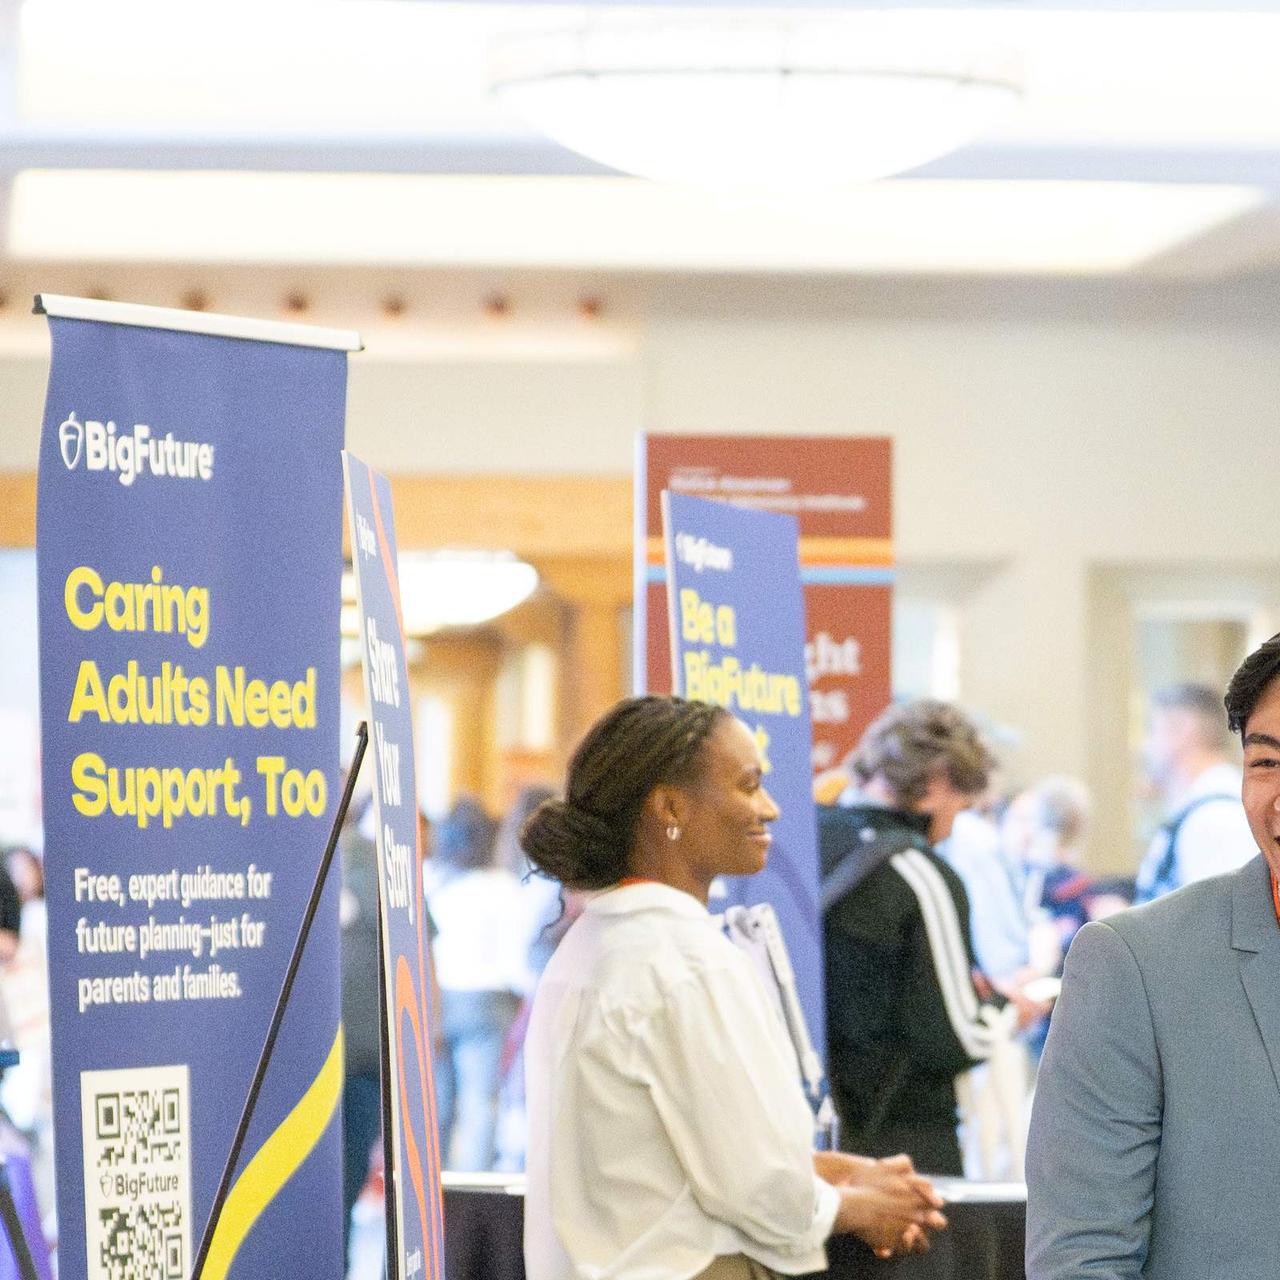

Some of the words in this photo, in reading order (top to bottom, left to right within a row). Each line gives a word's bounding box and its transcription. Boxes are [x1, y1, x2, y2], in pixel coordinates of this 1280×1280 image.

[85, 420, 213, 486] BigFuture
[64, 566, 209, 649] Caring
[68, 660, 211, 727] Adults
[216, 665, 317, 729] Need
[368, 617, 399, 708] Share
[71, 752, 251, 829] Support,
[256, 756, 327, 818] Too
[375, 720, 401, 807] Your
[74, 867, 125, 907] Free,
[128, 868, 179, 909] expert
[180, 865, 245, 908] guidance
[247, 864, 272, 898] for
[384, 823, 414, 926] Story
[75, 916, 136, 953] future
[240, 913, 265, 948] for
[78, 971, 151, 1013] parents
[153, 964, 181, 1002] and
[183, 963, 242, 1000] families.
[115, 1172, 179, 1202] BigFuture
